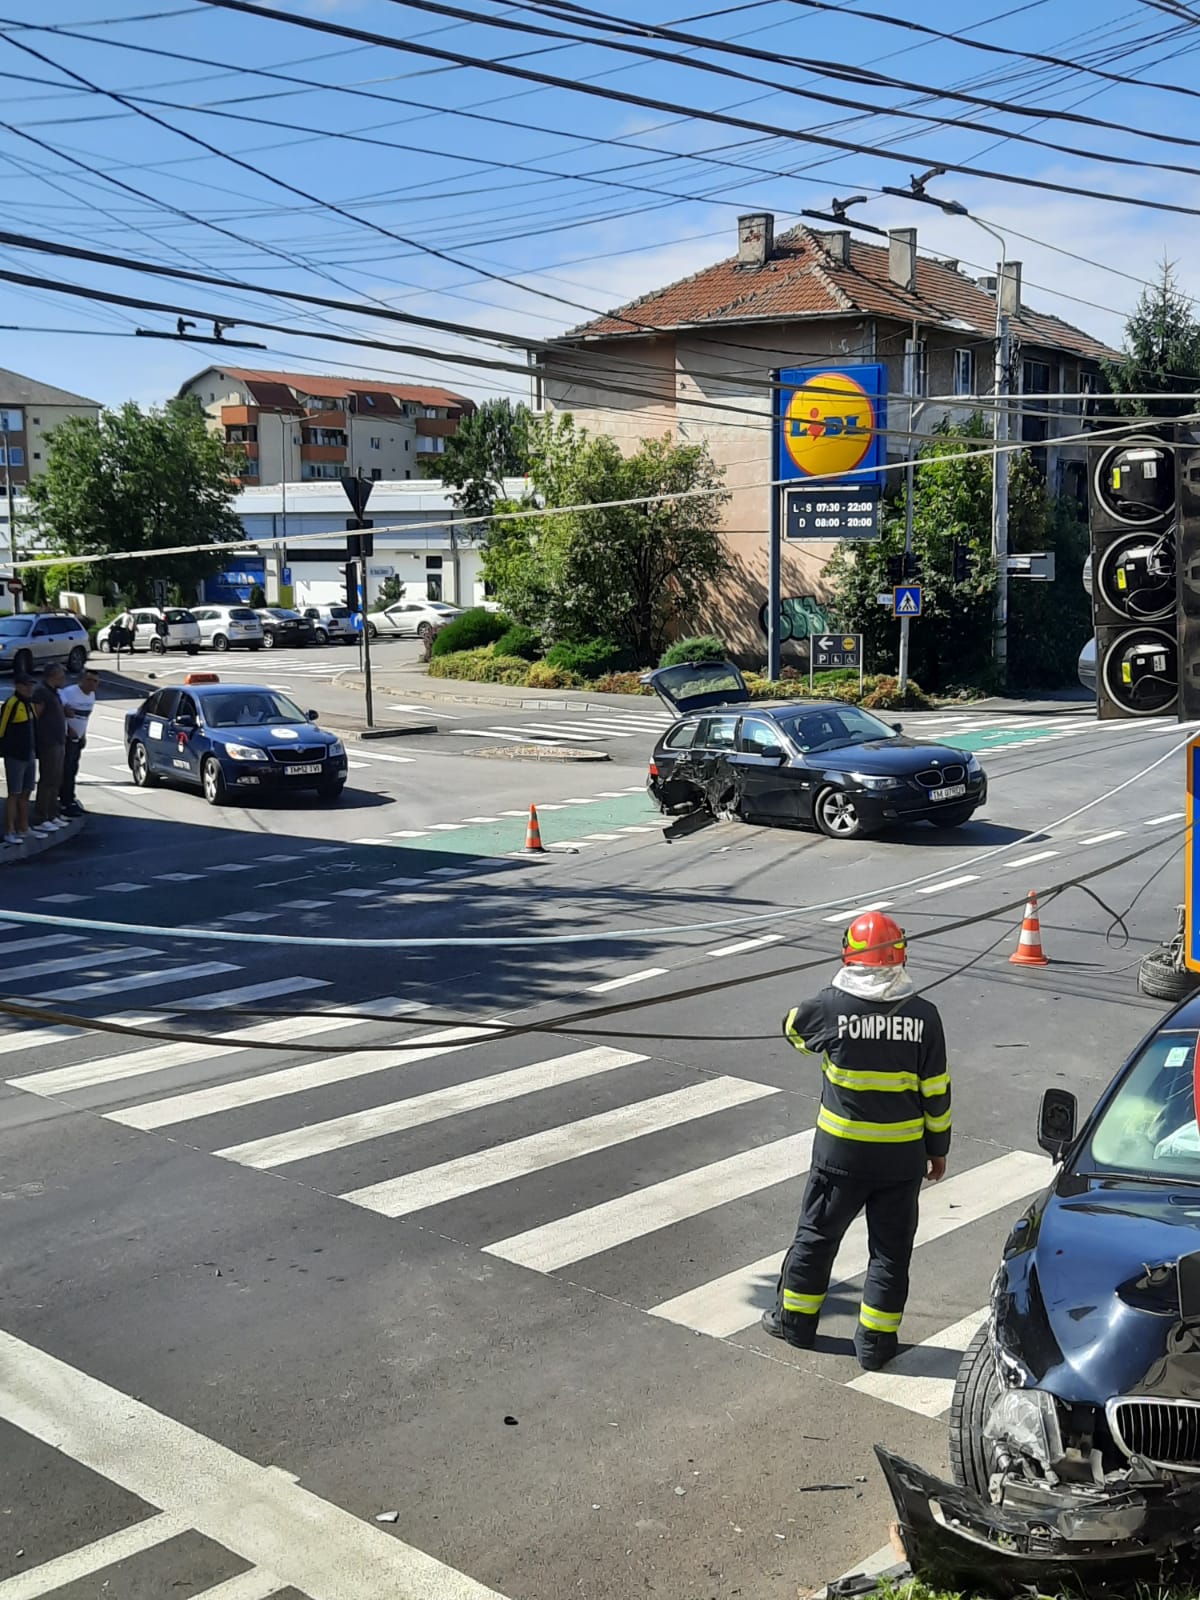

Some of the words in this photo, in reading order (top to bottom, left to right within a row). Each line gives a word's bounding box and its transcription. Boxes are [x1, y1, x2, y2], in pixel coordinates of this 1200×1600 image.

[816, 503, 840, 512] 07:30
[847, 502, 873, 512] 22:00
[800, 518, 806, 528] D
[815, 518, 840, 527] 08:00
[847, 518, 873, 527] 20:00
